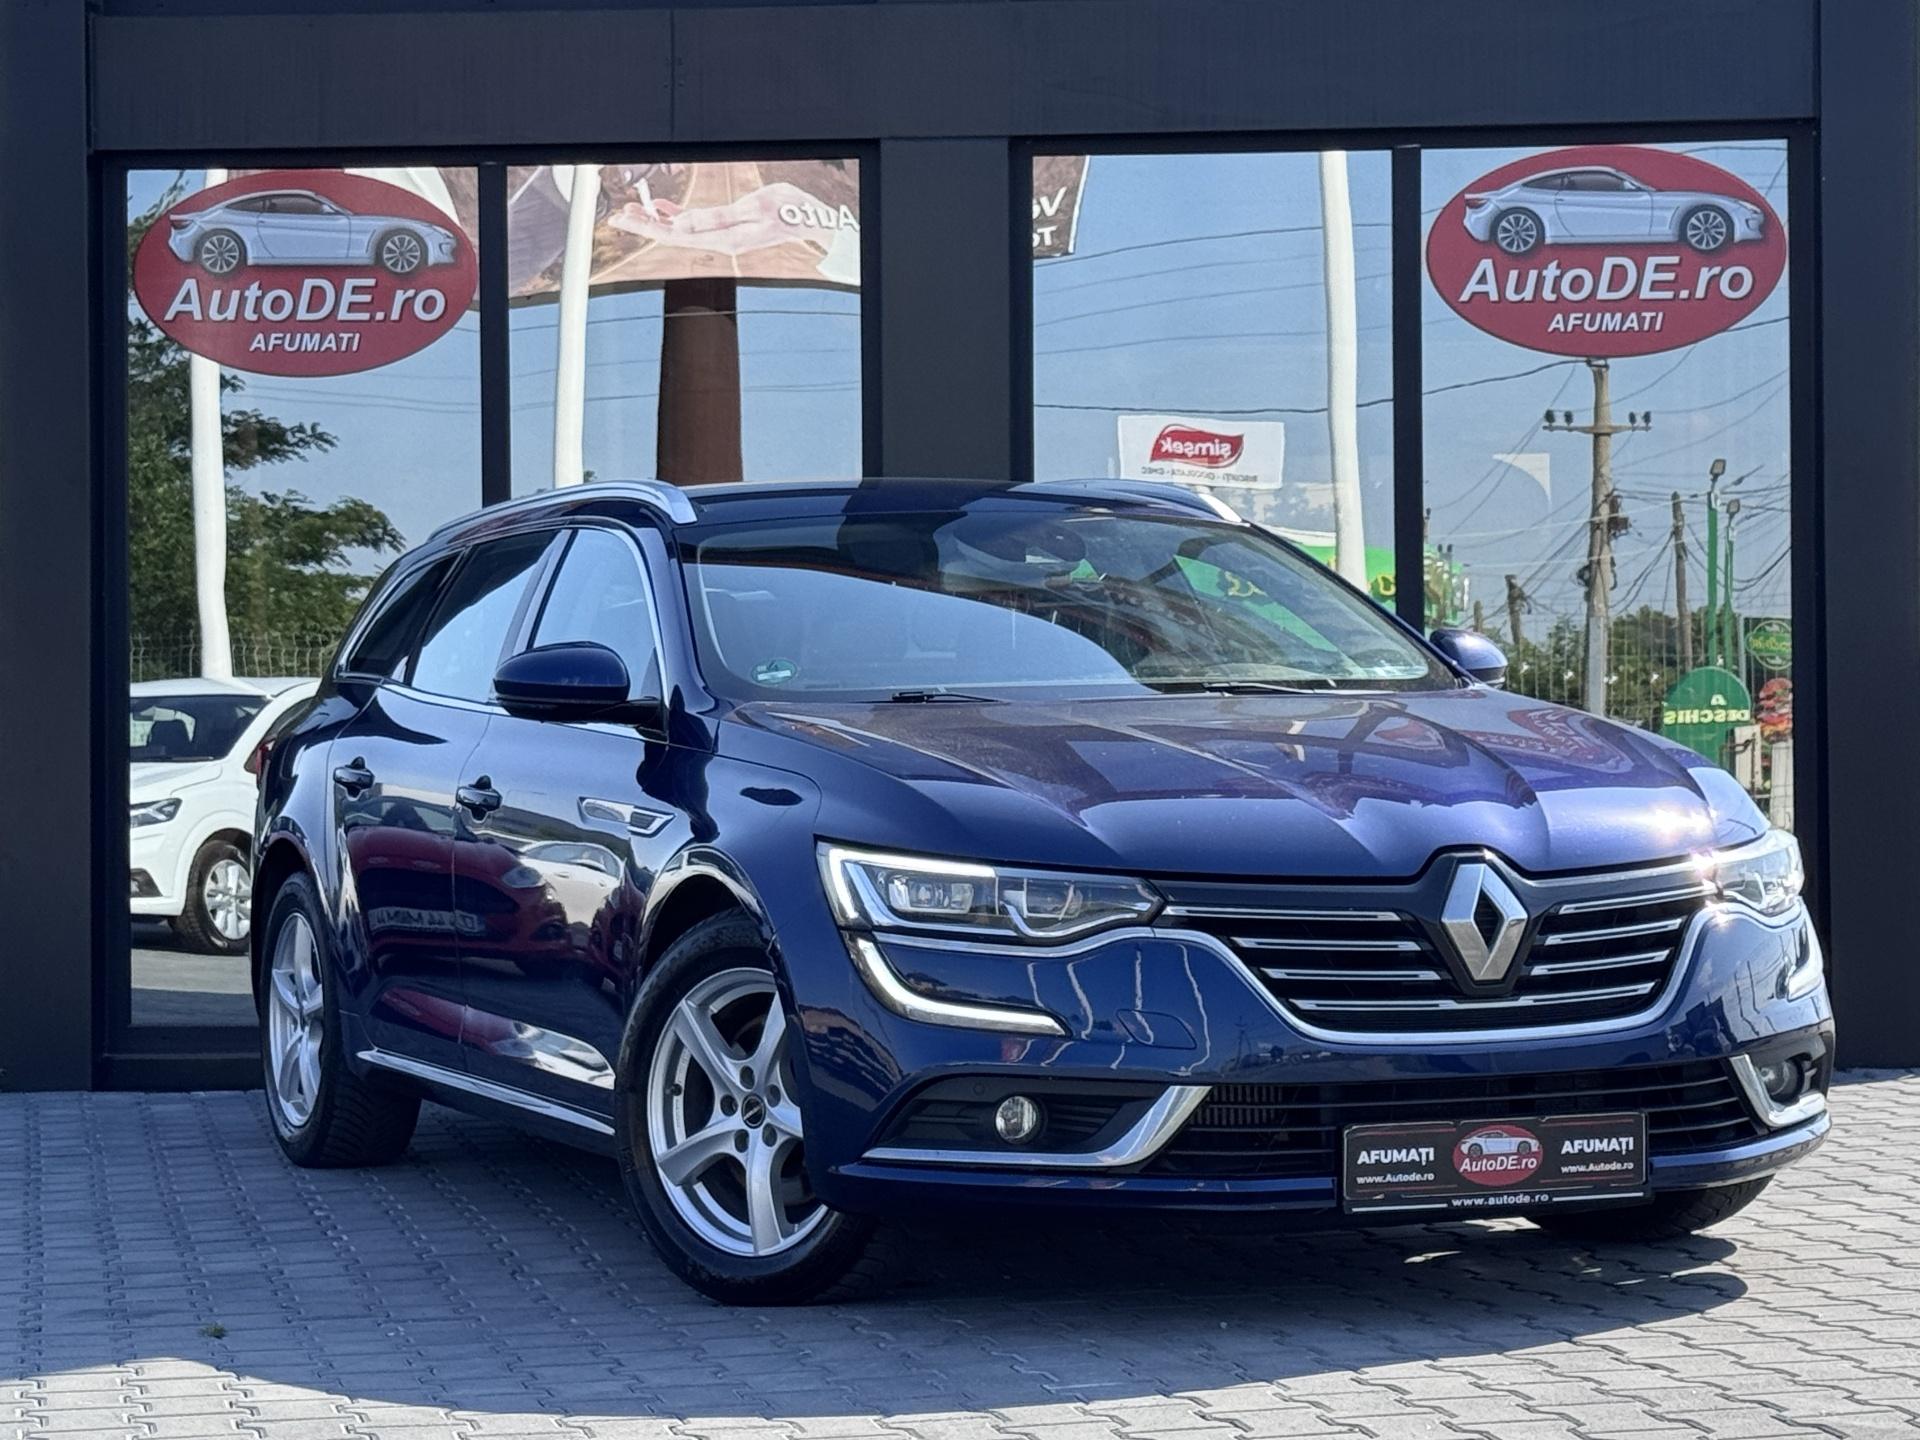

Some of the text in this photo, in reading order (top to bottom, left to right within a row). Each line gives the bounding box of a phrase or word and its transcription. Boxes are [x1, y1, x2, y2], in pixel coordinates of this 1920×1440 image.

[1458, 255, 1754, 303] AutoDE.ro
[163, 278, 447, 322] AutoDE.ro
[1547, 311, 1665, 333] AFUMATI
[248, 332, 361, 352] AFUMATI
[1459, 1155, 1537, 1173] AutoDE.ro
[1560, 1160, 1634, 1174] www.Autode.ro
[1356, 1172, 1435, 1184] www.Autode.ro
[1451, 1193, 1549, 1207] www.autode.ro
